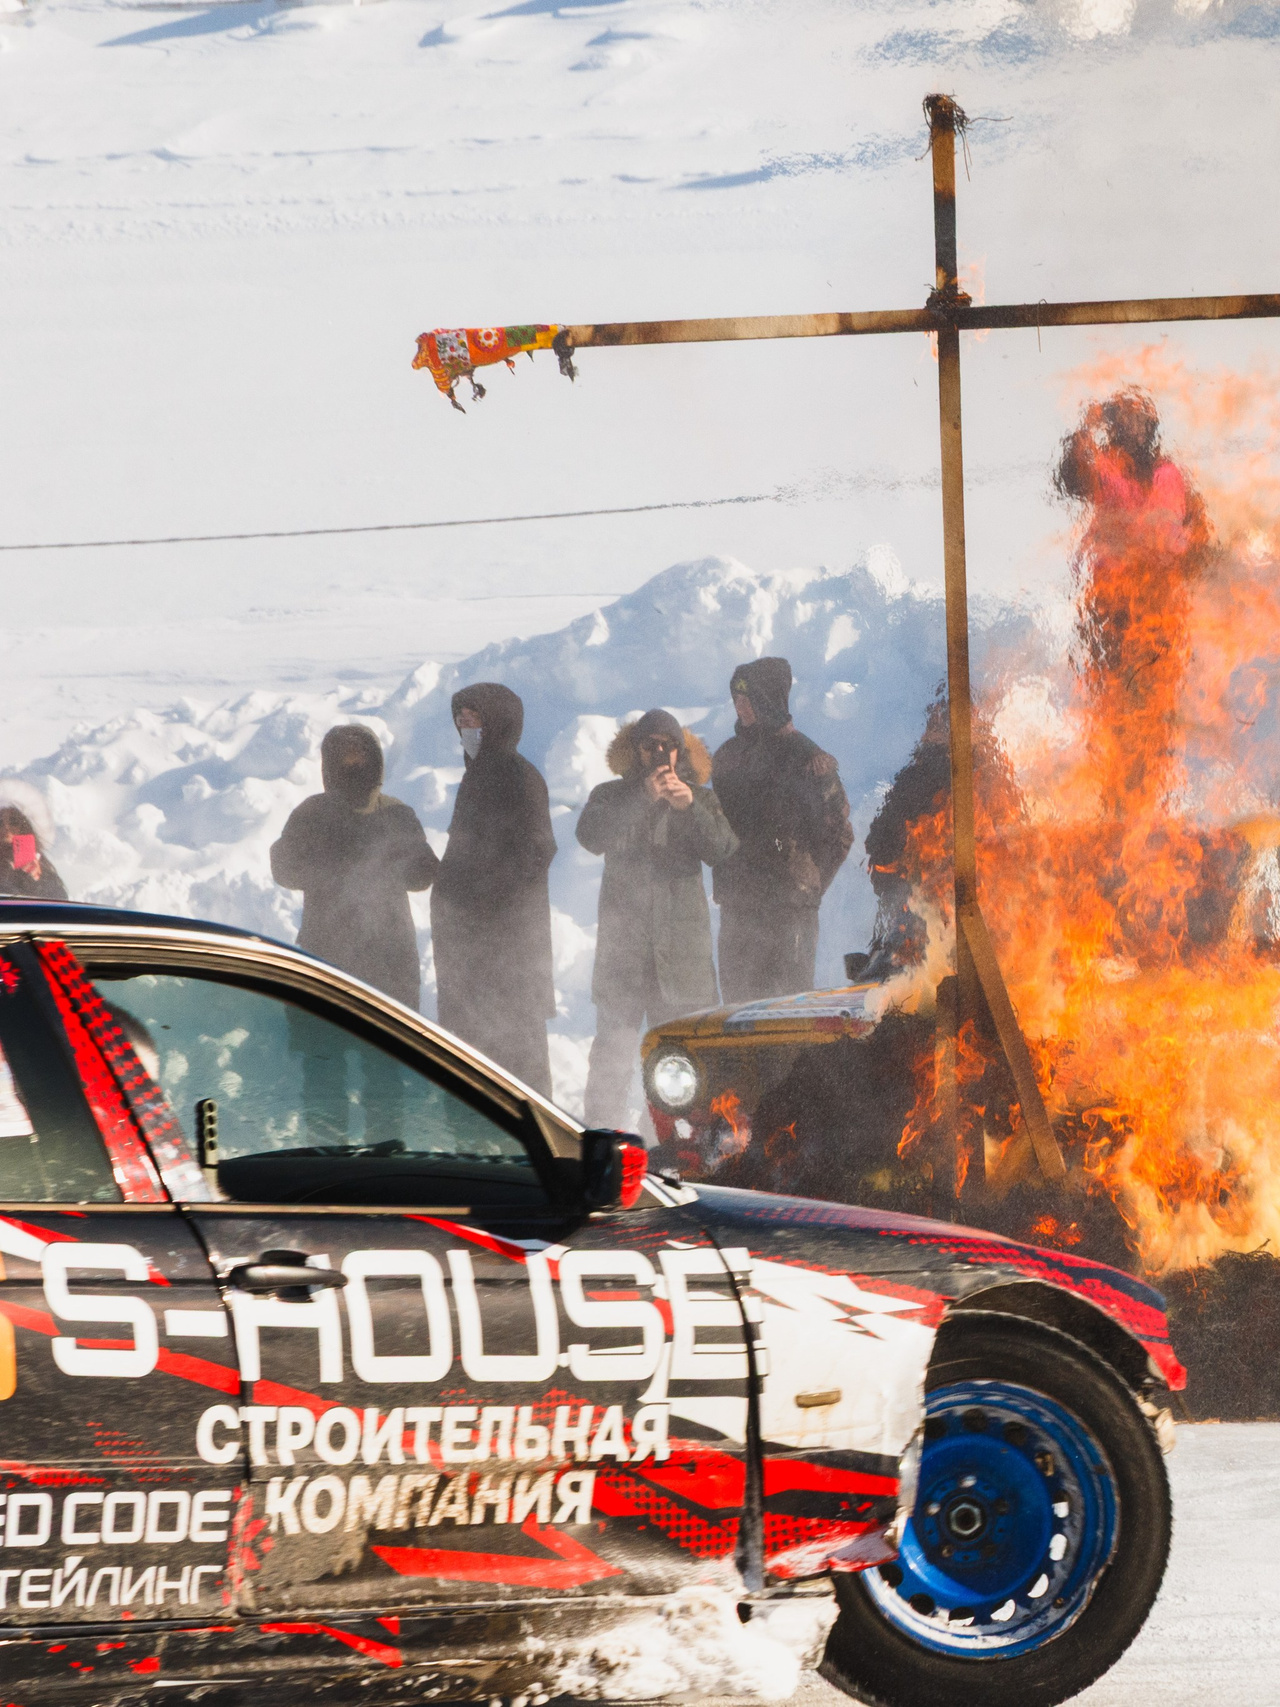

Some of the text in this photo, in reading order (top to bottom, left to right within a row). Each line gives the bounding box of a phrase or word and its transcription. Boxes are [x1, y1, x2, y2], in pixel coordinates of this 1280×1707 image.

[41, 1241, 771, 1382] S-HOUSE
[196, 1403, 671, 1466] СТРОИТЕЛЬНАЯ
[0, 1490, 232, 1547] D CODE
[265, 1469, 598, 1536] КОМПАНИЯ
